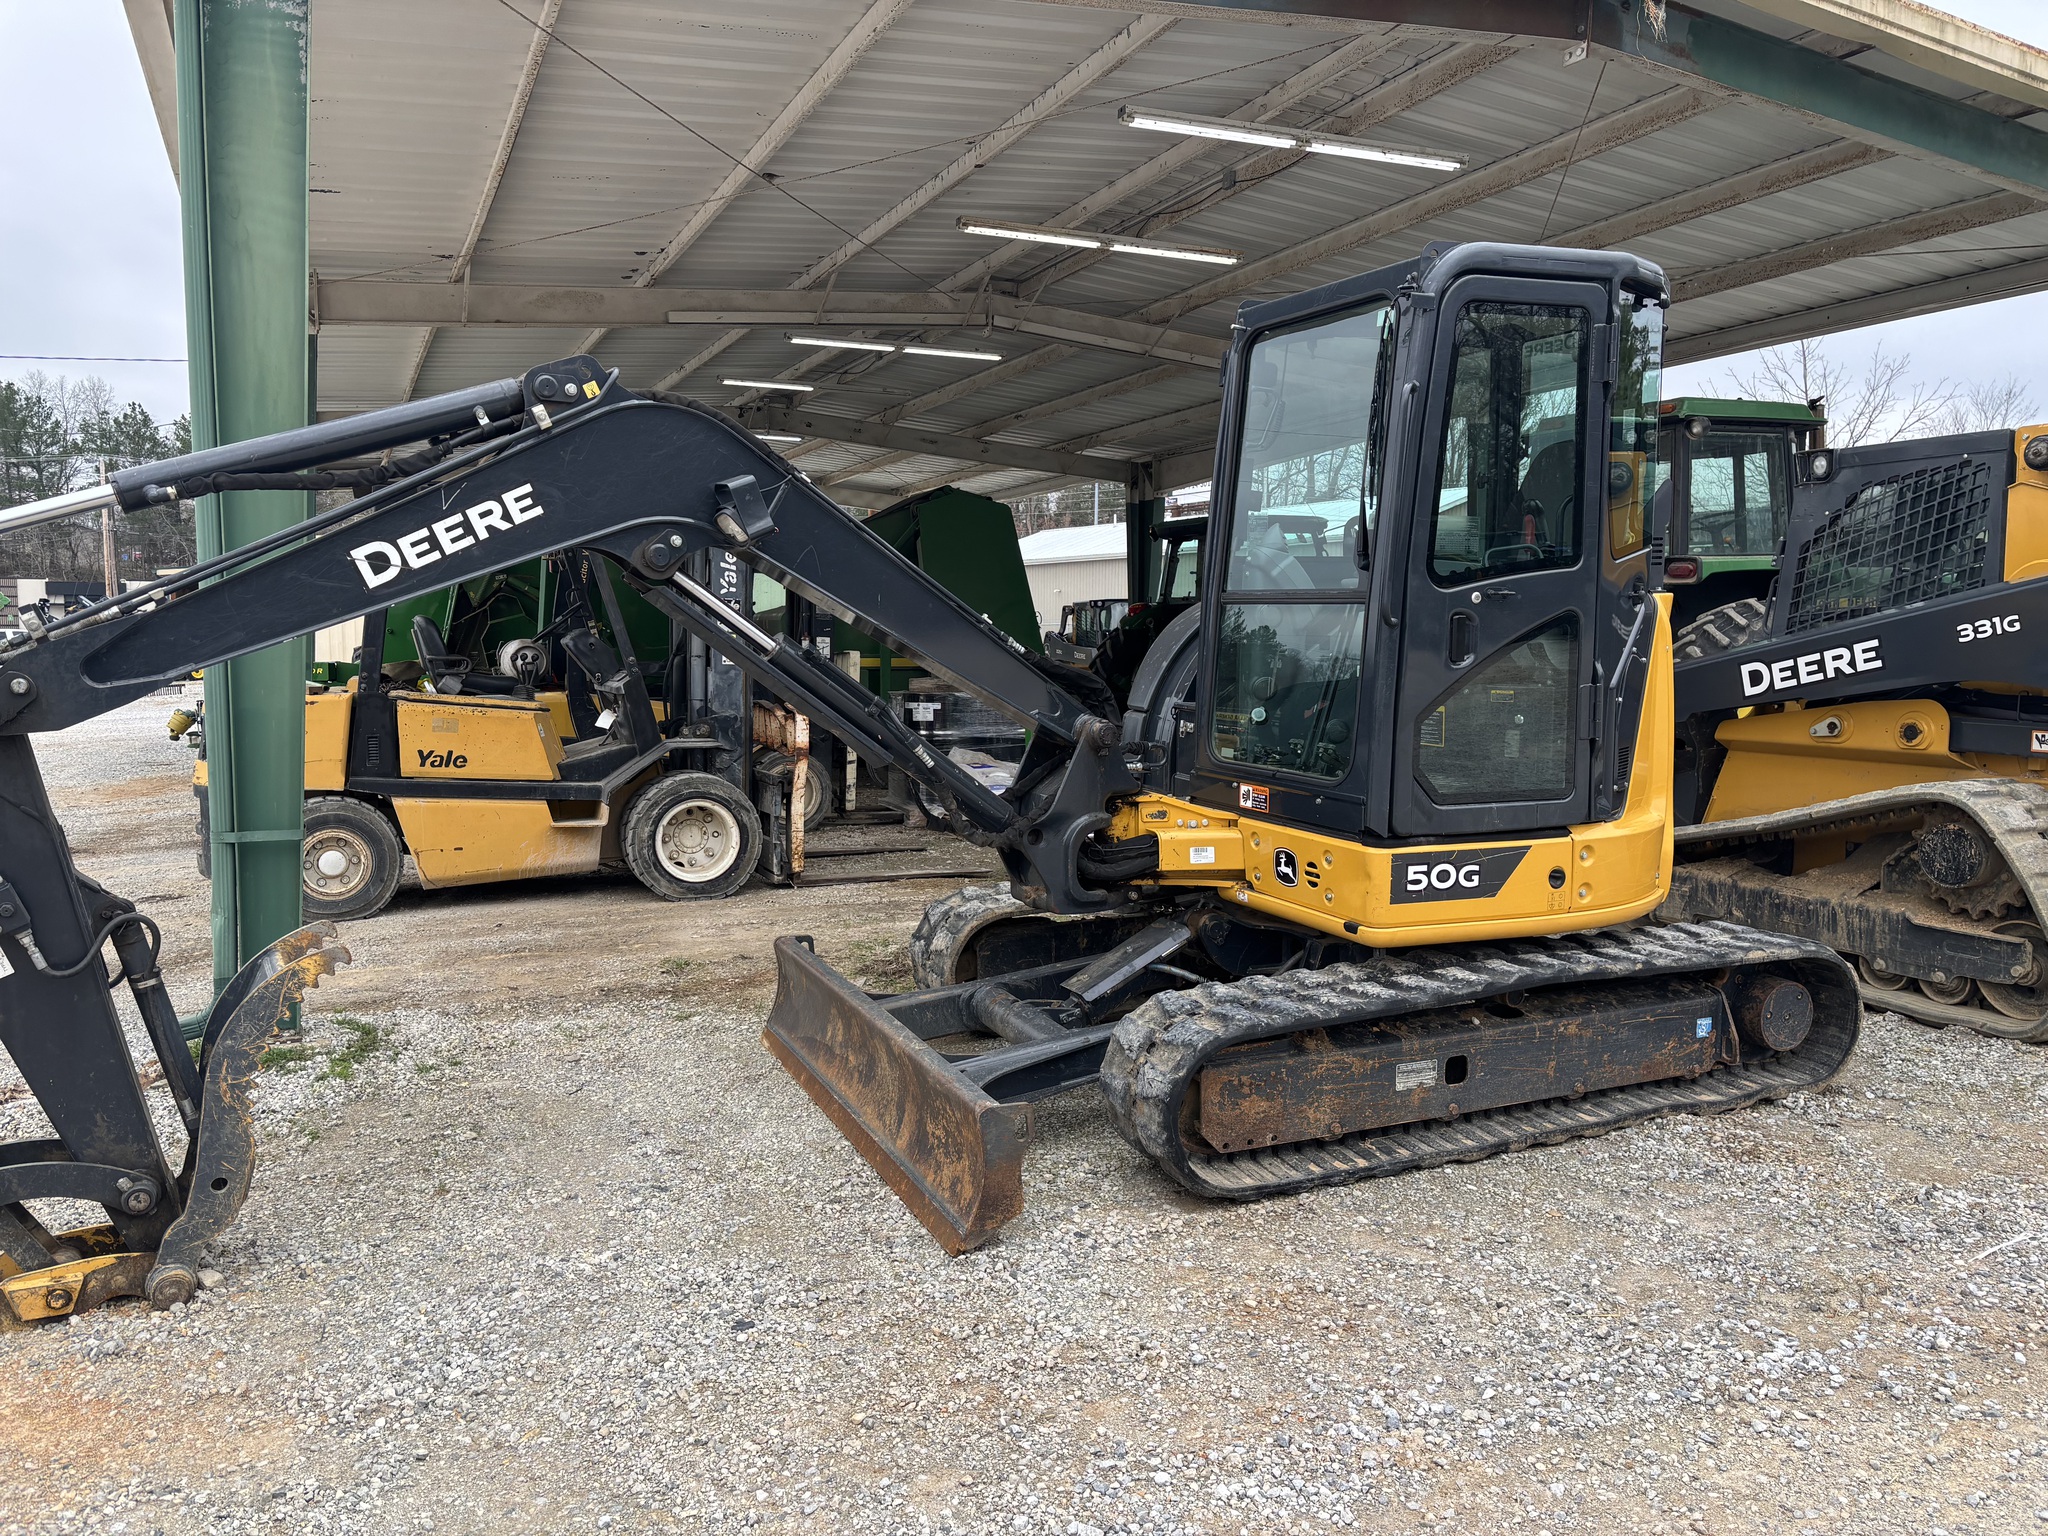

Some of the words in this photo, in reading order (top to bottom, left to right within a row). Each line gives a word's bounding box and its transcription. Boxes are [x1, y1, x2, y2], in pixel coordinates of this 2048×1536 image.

[350, 483, 543, 589] DEERE
[719, 551, 738, 595] Yale
[1956, 614, 2021, 643] 331G
[1740, 638, 1883, 697] DEERE
[417, 749, 468, 769] Yale
[1406, 863, 1480, 891] 50G
